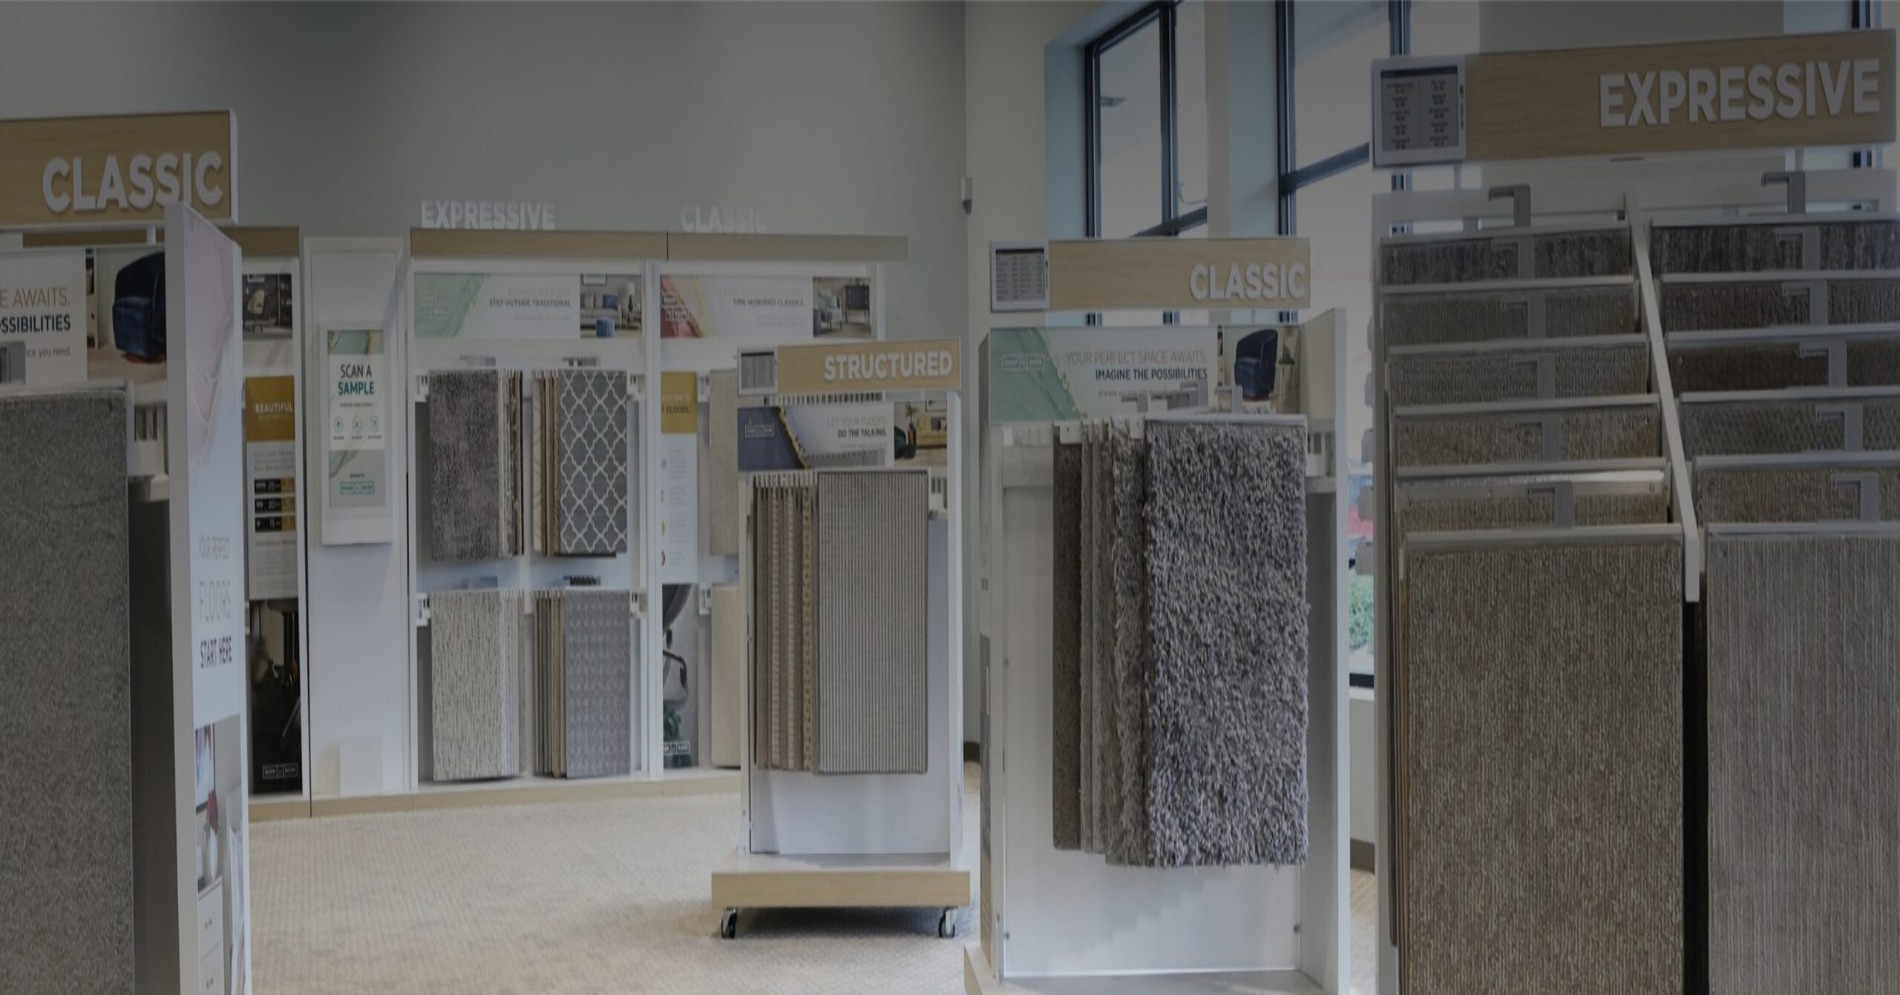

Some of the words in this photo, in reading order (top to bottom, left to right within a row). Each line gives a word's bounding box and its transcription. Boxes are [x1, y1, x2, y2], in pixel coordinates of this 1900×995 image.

[1600, 58, 1881, 128] EXPRESSIVE
[42, 150, 223, 213] CLASSIC
[420, 199, 556, 230] EXPRESSIVE
[680, 204, 770, 233] CLASSIC
[1189, 262, 1306, 301] CLASSIC
[13, 285, 71, 308] AWAITS.
[489, 298, 504, 307] STEP
[505, 298, 530, 307] OUTSIDE
[0, 313, 71, 335] SSIBILITIES
[824, 350, 953, 381] STRUCTURED
[1066, 350, 1093, 366] YOUR
[1094, 350, 1136, 366] PERFECT
[1138, 350, 1168, 365] SPACE
[1169, 349, 1208, 365] AWAITS.
[340, 363, 364, 378] SCAN
[366, 363, 372, 378] A
[1095, 368, 1131, 381] IMAGINE
[1133, 368, 1149, 381] THE
[1151, 368, 1208, 381] POSSIBILITIES
[338, 380, 375, 396] SAMPLE
[255, 402, 294, 415] BEAUTIFUL
[837, 428, 847, 438] DO
[848, 428, 859, 438] THE
[199, 578, 232, 622] FLOORS
[200, 638, 217, 670] START
[218, 635, 232, 665] HERE
